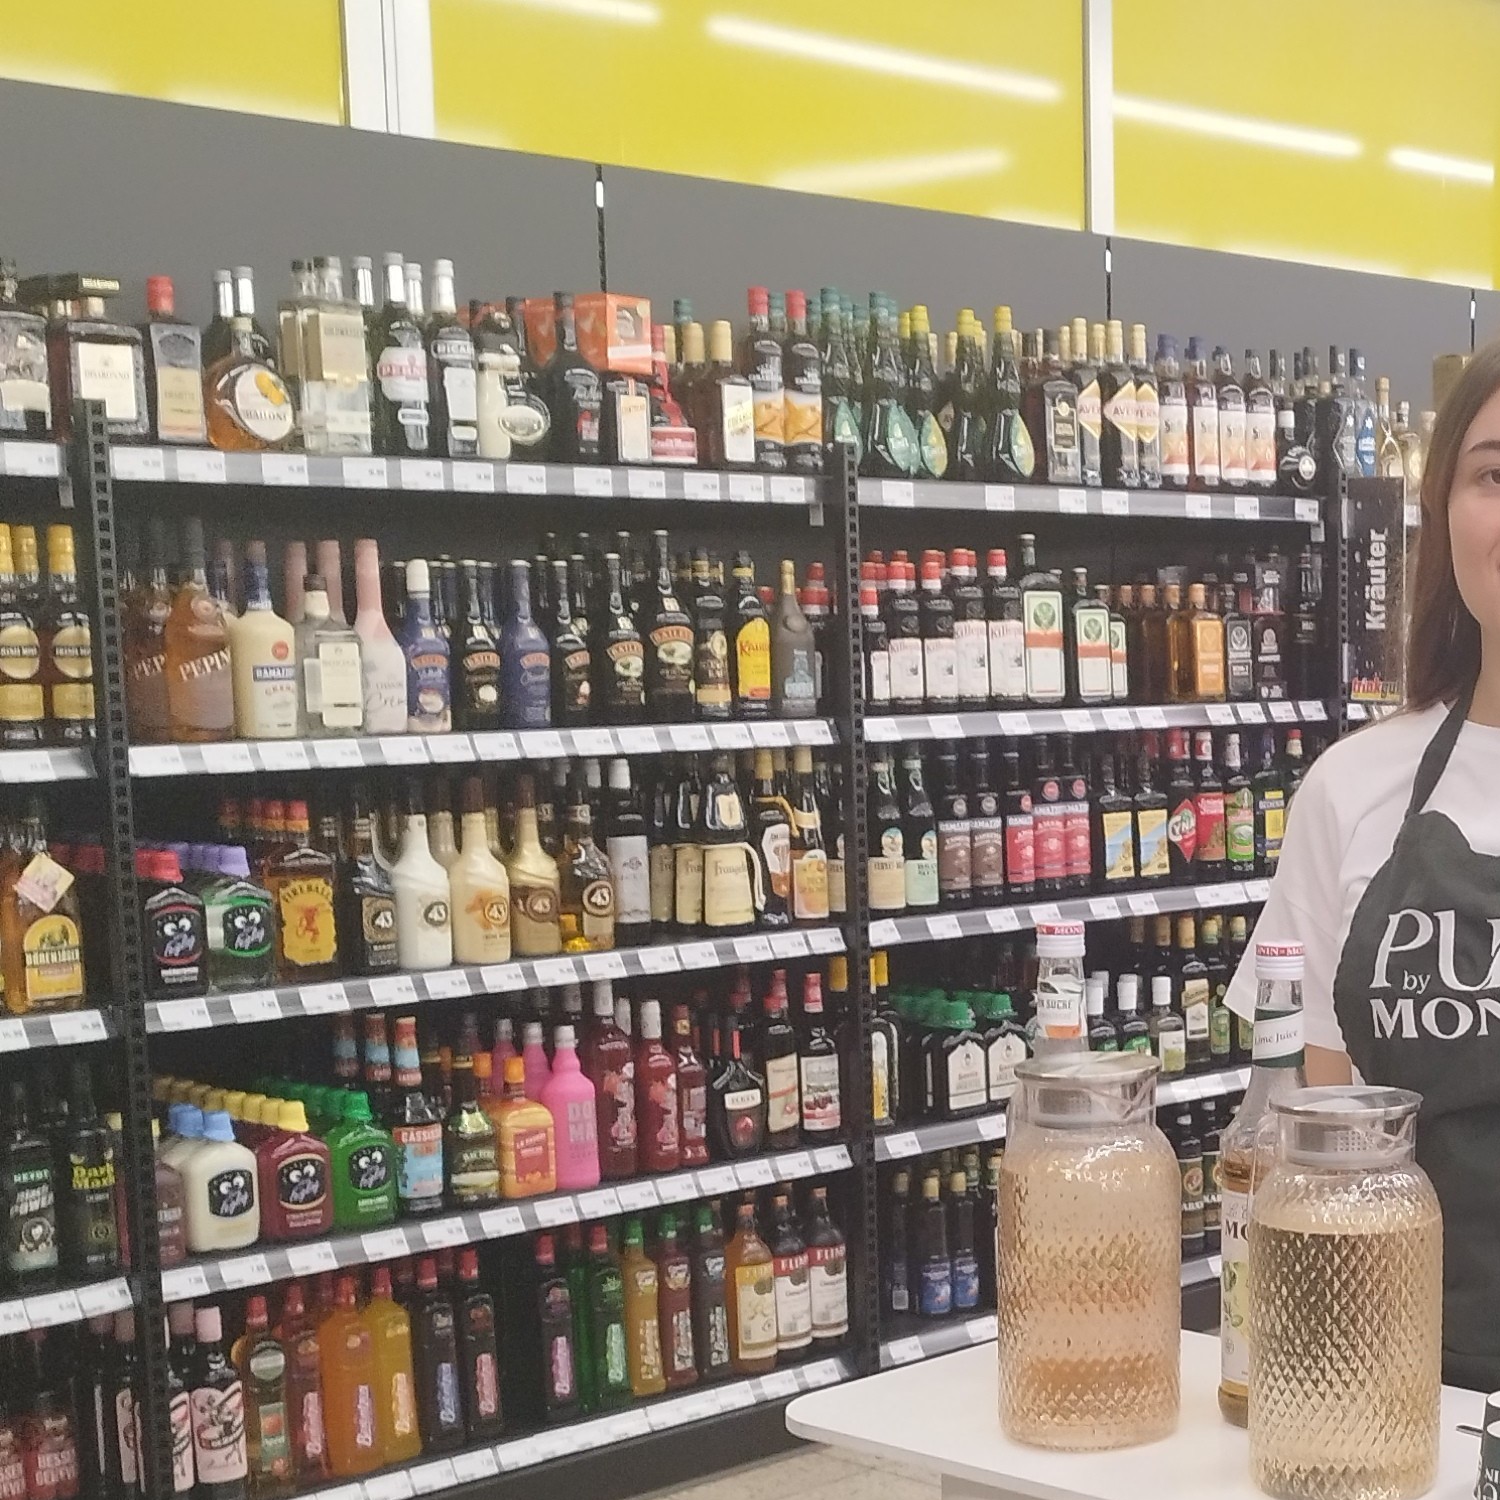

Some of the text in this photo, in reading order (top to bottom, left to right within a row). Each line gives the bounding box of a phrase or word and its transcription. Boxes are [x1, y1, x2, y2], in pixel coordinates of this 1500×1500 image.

[1365, 528, 1388, 630] Kräuter
[179, 647, 231, 683] PEPIN
[1168, 808, 1196, 842] CYNA
[714, 861, 747, 877] Frangel
[282, 877, 332, 904] FIREBALL
[490, 904, 507, 920] 43
[1054, 926, 1081, 935] MON
[1258, 947, 1279, 957] NIN
[1403, 970, 1431, 994] by
[1275, 1030, 1298, 1043] Juice
